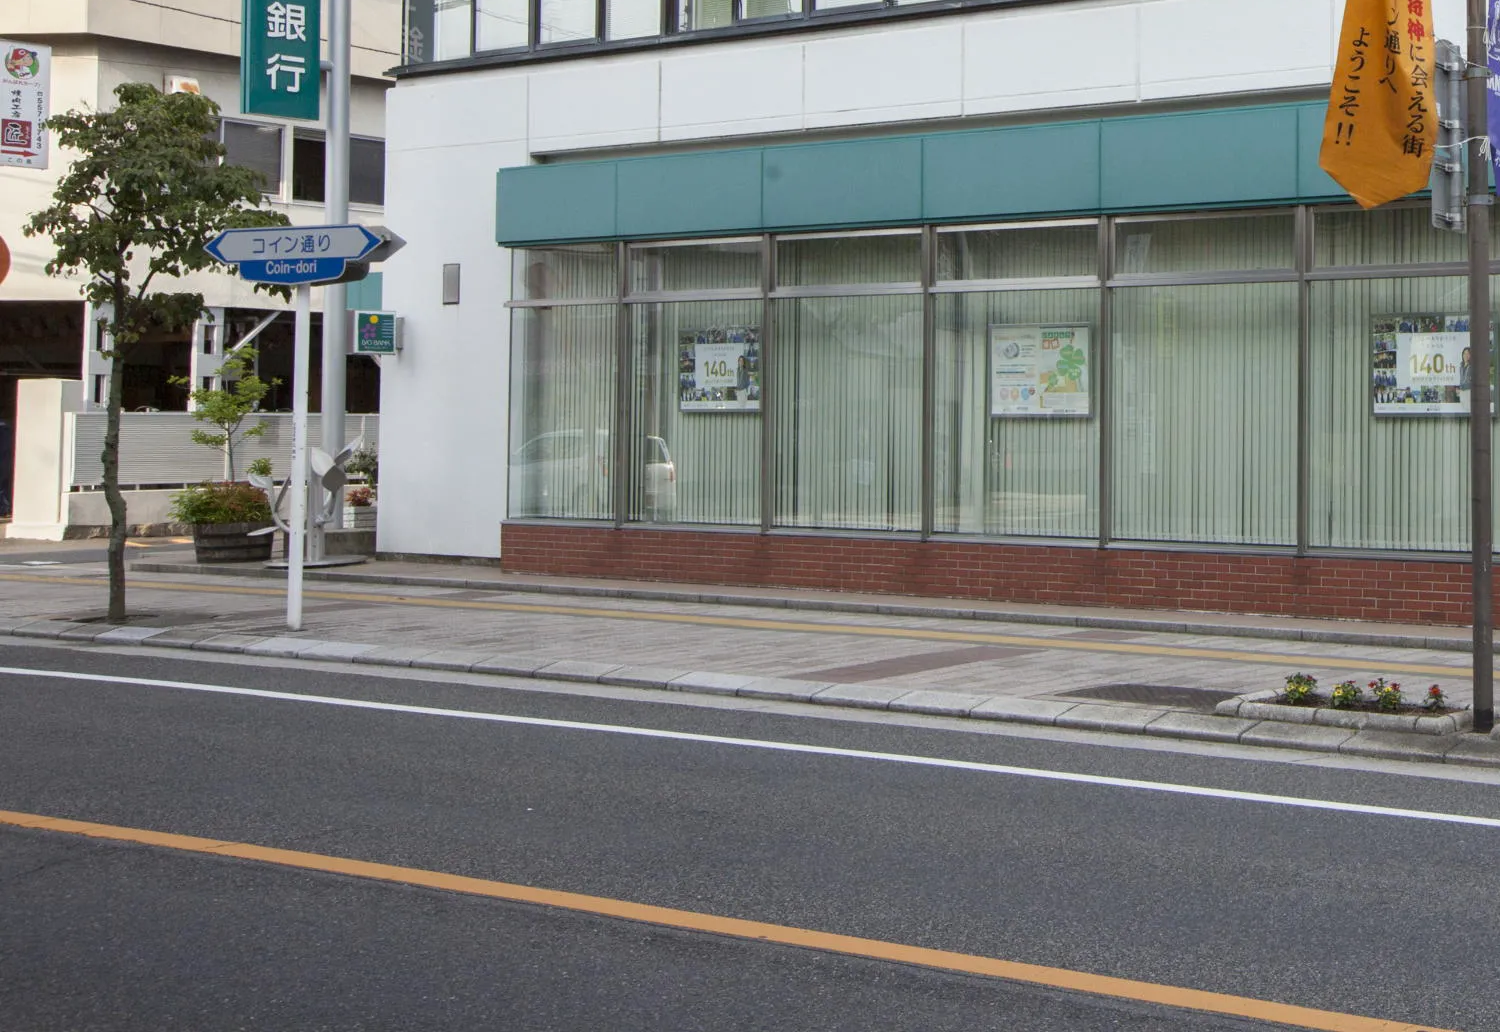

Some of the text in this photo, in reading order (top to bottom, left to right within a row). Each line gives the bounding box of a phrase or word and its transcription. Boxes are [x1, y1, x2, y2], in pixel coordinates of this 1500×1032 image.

[252, 234, 331, 254] コイン通り
[266, 260, 317, 275] Coin-dori
